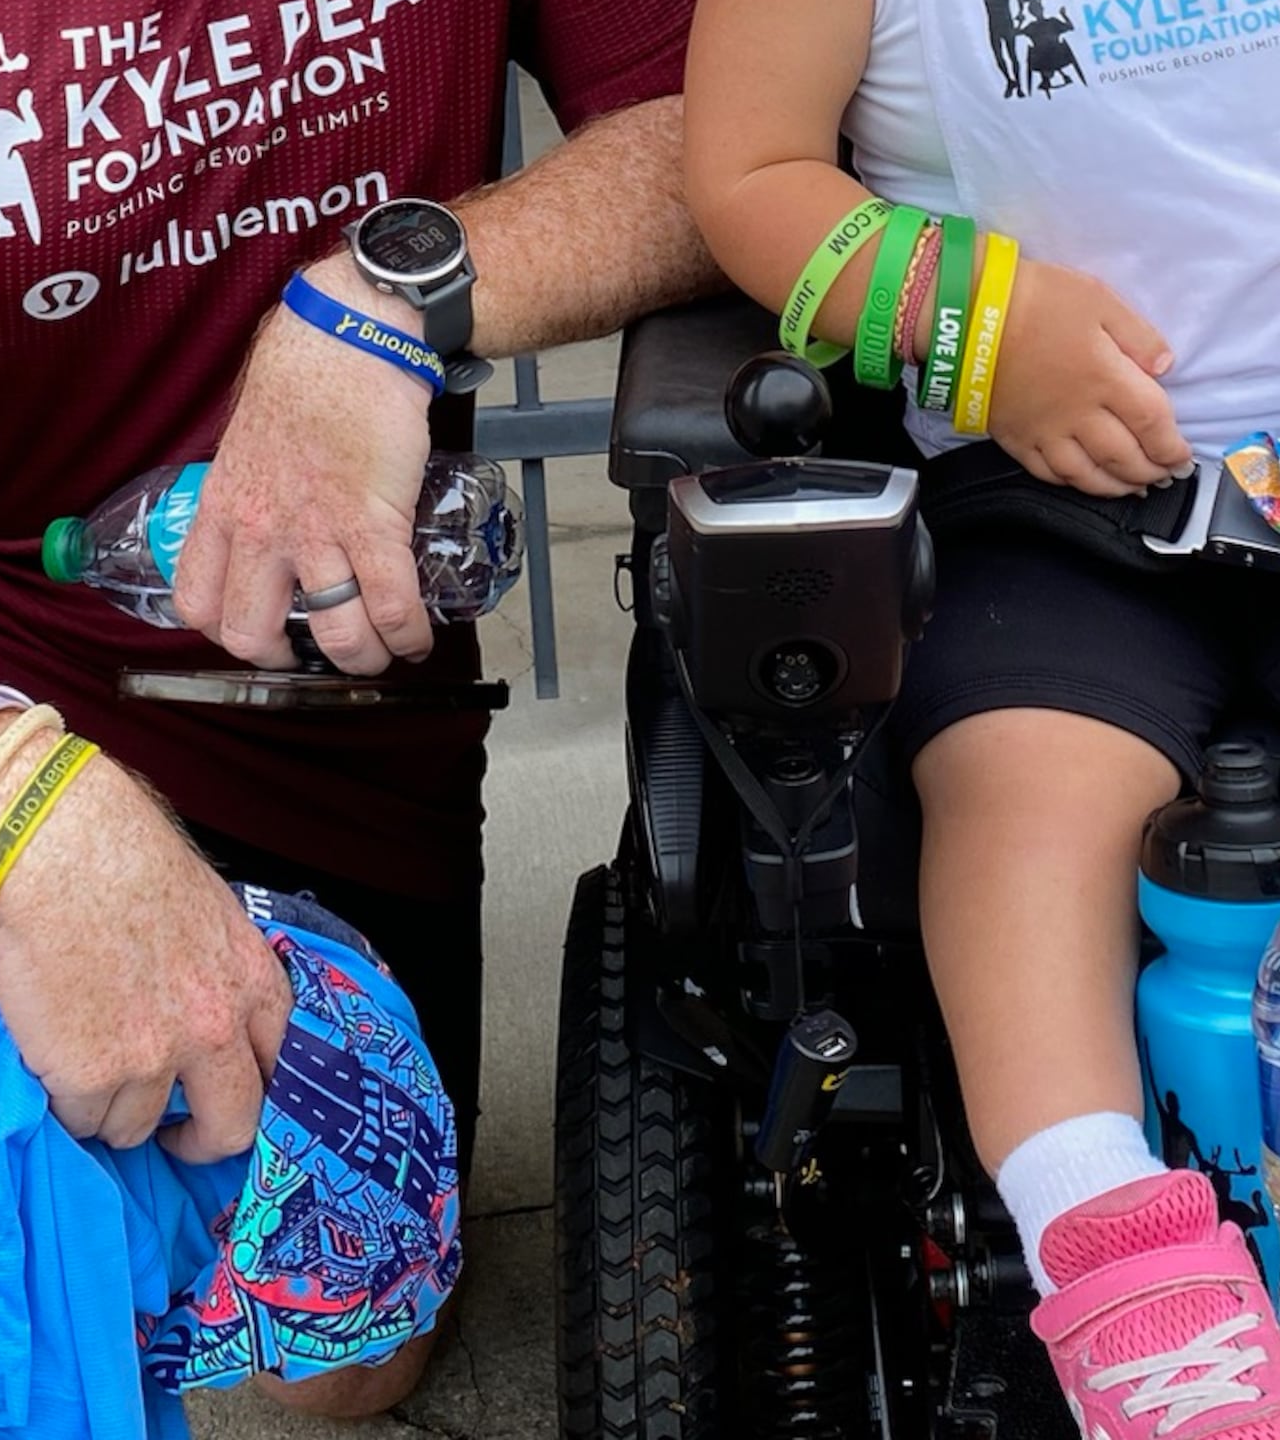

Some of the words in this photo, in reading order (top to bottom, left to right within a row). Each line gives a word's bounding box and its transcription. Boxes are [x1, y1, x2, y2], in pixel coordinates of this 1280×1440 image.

[61, 10, 163, 71] THE
[1098, 60, 1167, 84] PUSHING
[1173, 48, 1236, 70] BEYOND
[66, 14, 262, 149] KYLE
[67, 37, 385, 203] FOUNDATION
[66, 173, 185, 238] PUSHING
[194, 123, 289, 176] BEYOND
[301, 92, 391, 140] LIMITS
[120, 169, 390, 285] lululemon
[827, 201, 892, 257] E.COM
[934, 359, 956, 373] A
[938, 306, 963, 358] LOVE
[968, 306, 1001, 385] SPECIAL
